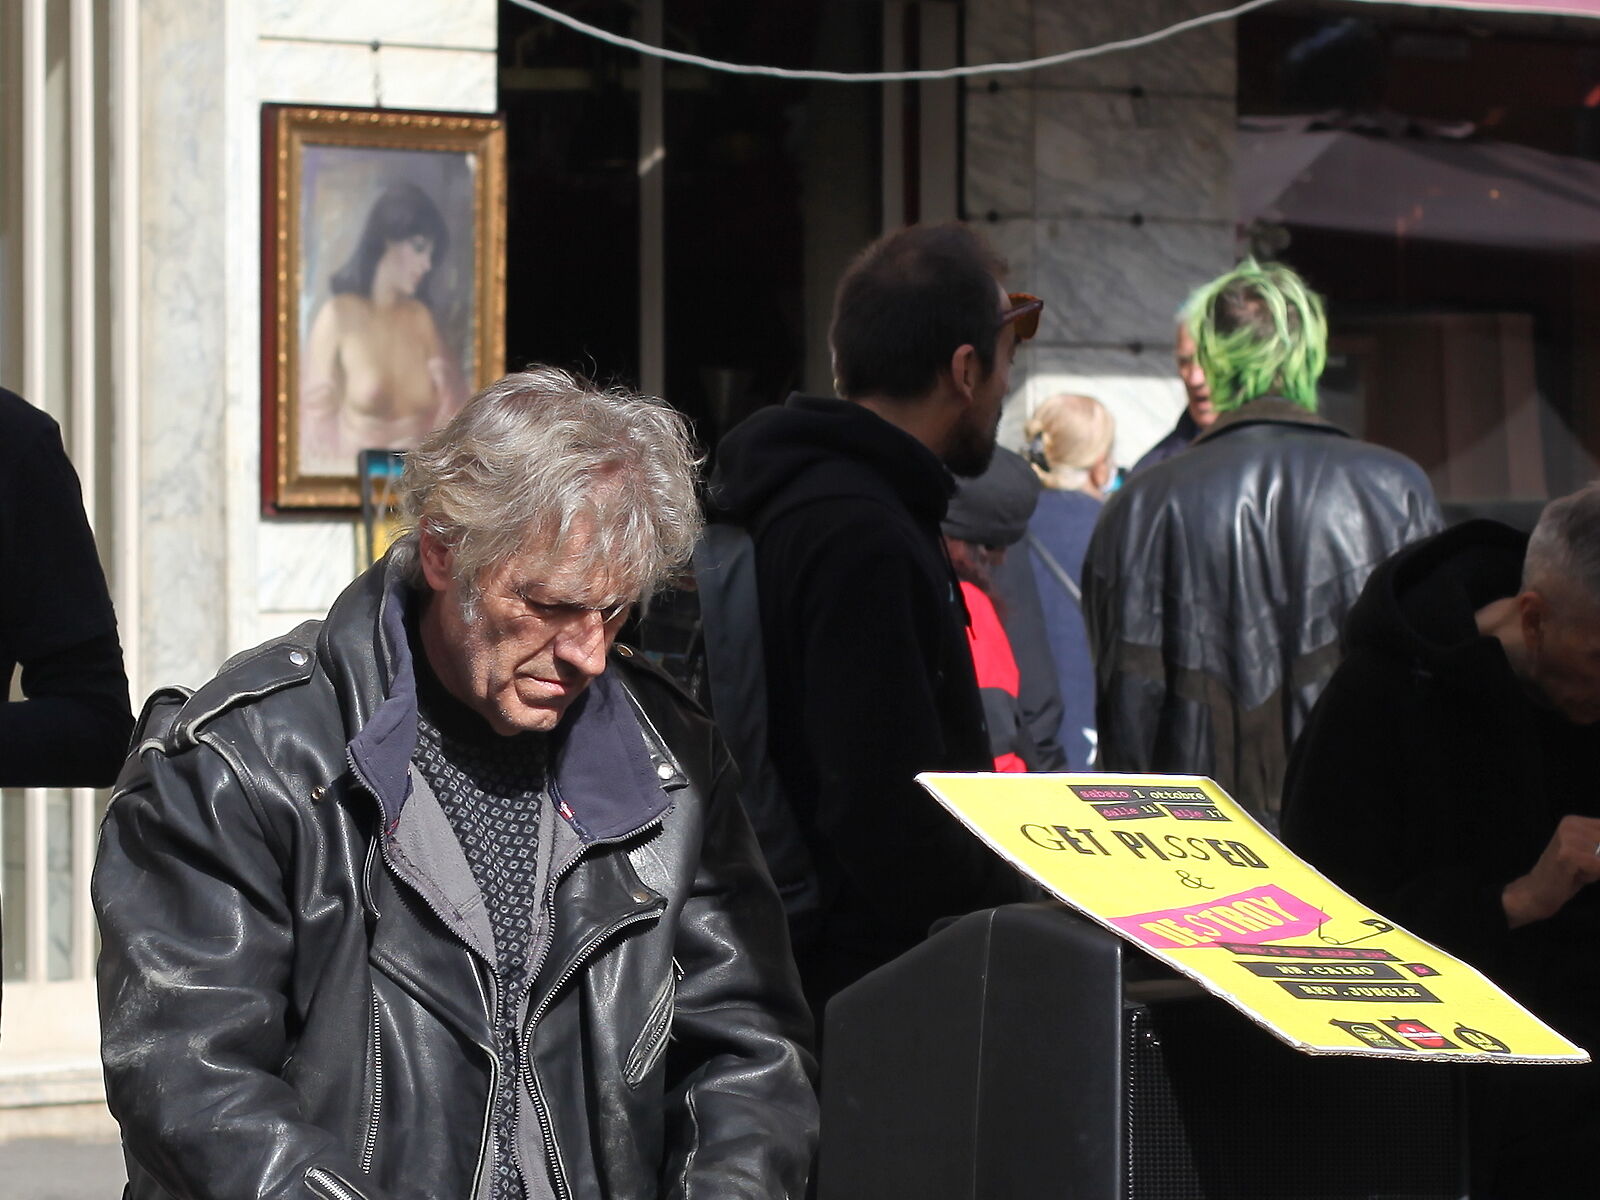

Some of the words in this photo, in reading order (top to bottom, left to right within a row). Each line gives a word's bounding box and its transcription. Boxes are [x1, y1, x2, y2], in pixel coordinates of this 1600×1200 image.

[1080, 789, 1129, 799] sabato
[1133, 789, 1145, 799] 1
[1150, 791, 1206, 801] ottobre
[1103, 807, 1139, 818] dalle
[1141, 805, 1159, 814] 11
[1173, 809, 1203, 818] alle
[1207, 810, 1223, 818] 17
[1020, 823, 1112, 856] GET
[1111, 830, 1269, 869] PISSED
[1175, 869, 1215, 890] &
[1139, 896, 1300, 947] DESTROY
[1275, 965, 1375, 976] MR.CAIRO
